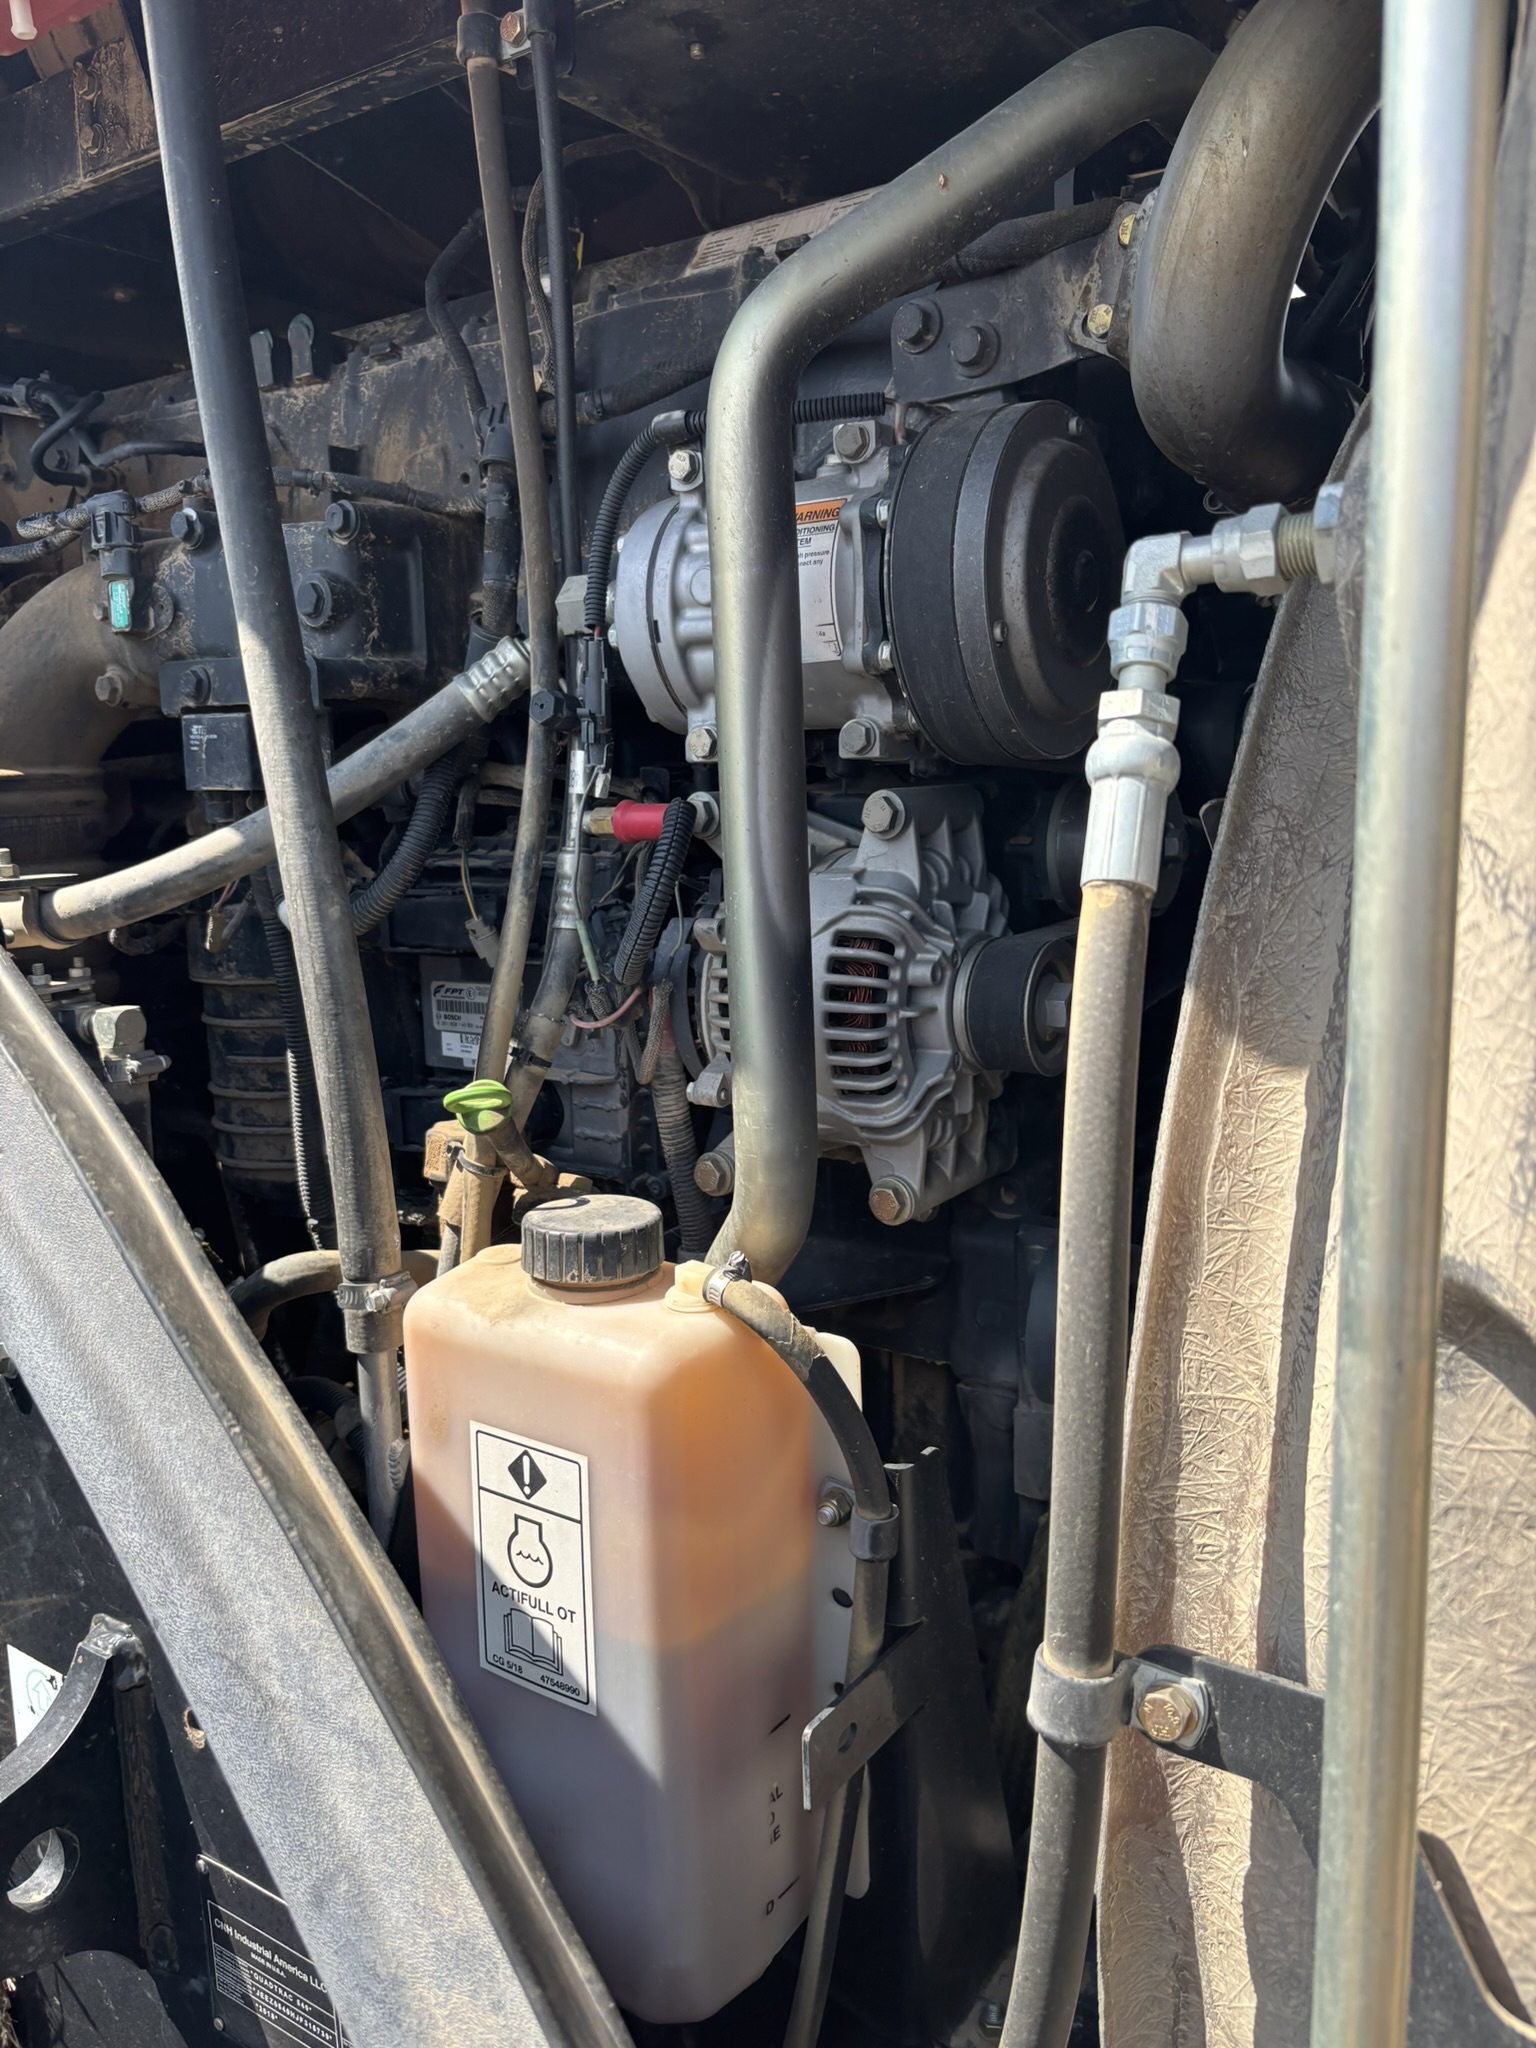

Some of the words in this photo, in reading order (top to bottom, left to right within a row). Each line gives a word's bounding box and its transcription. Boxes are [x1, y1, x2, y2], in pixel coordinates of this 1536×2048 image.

[796, 507, 840, 521] ARNING
[492, 1581, 554, 1616] ACTIFULL
[557, 1606, 577, 1623] OT
[492, 1654, 505, 1666] CG
[506, 1660, 523, 1674] 5/18
[540, 1674, 581, 1697] 47548990
[214, 1917, 233, 1937] CNH
[234, 1929, 272, 1961] Industrial
[273, 1953, 309, 1983] America
[309, 1975, 328, 1993] LLC
